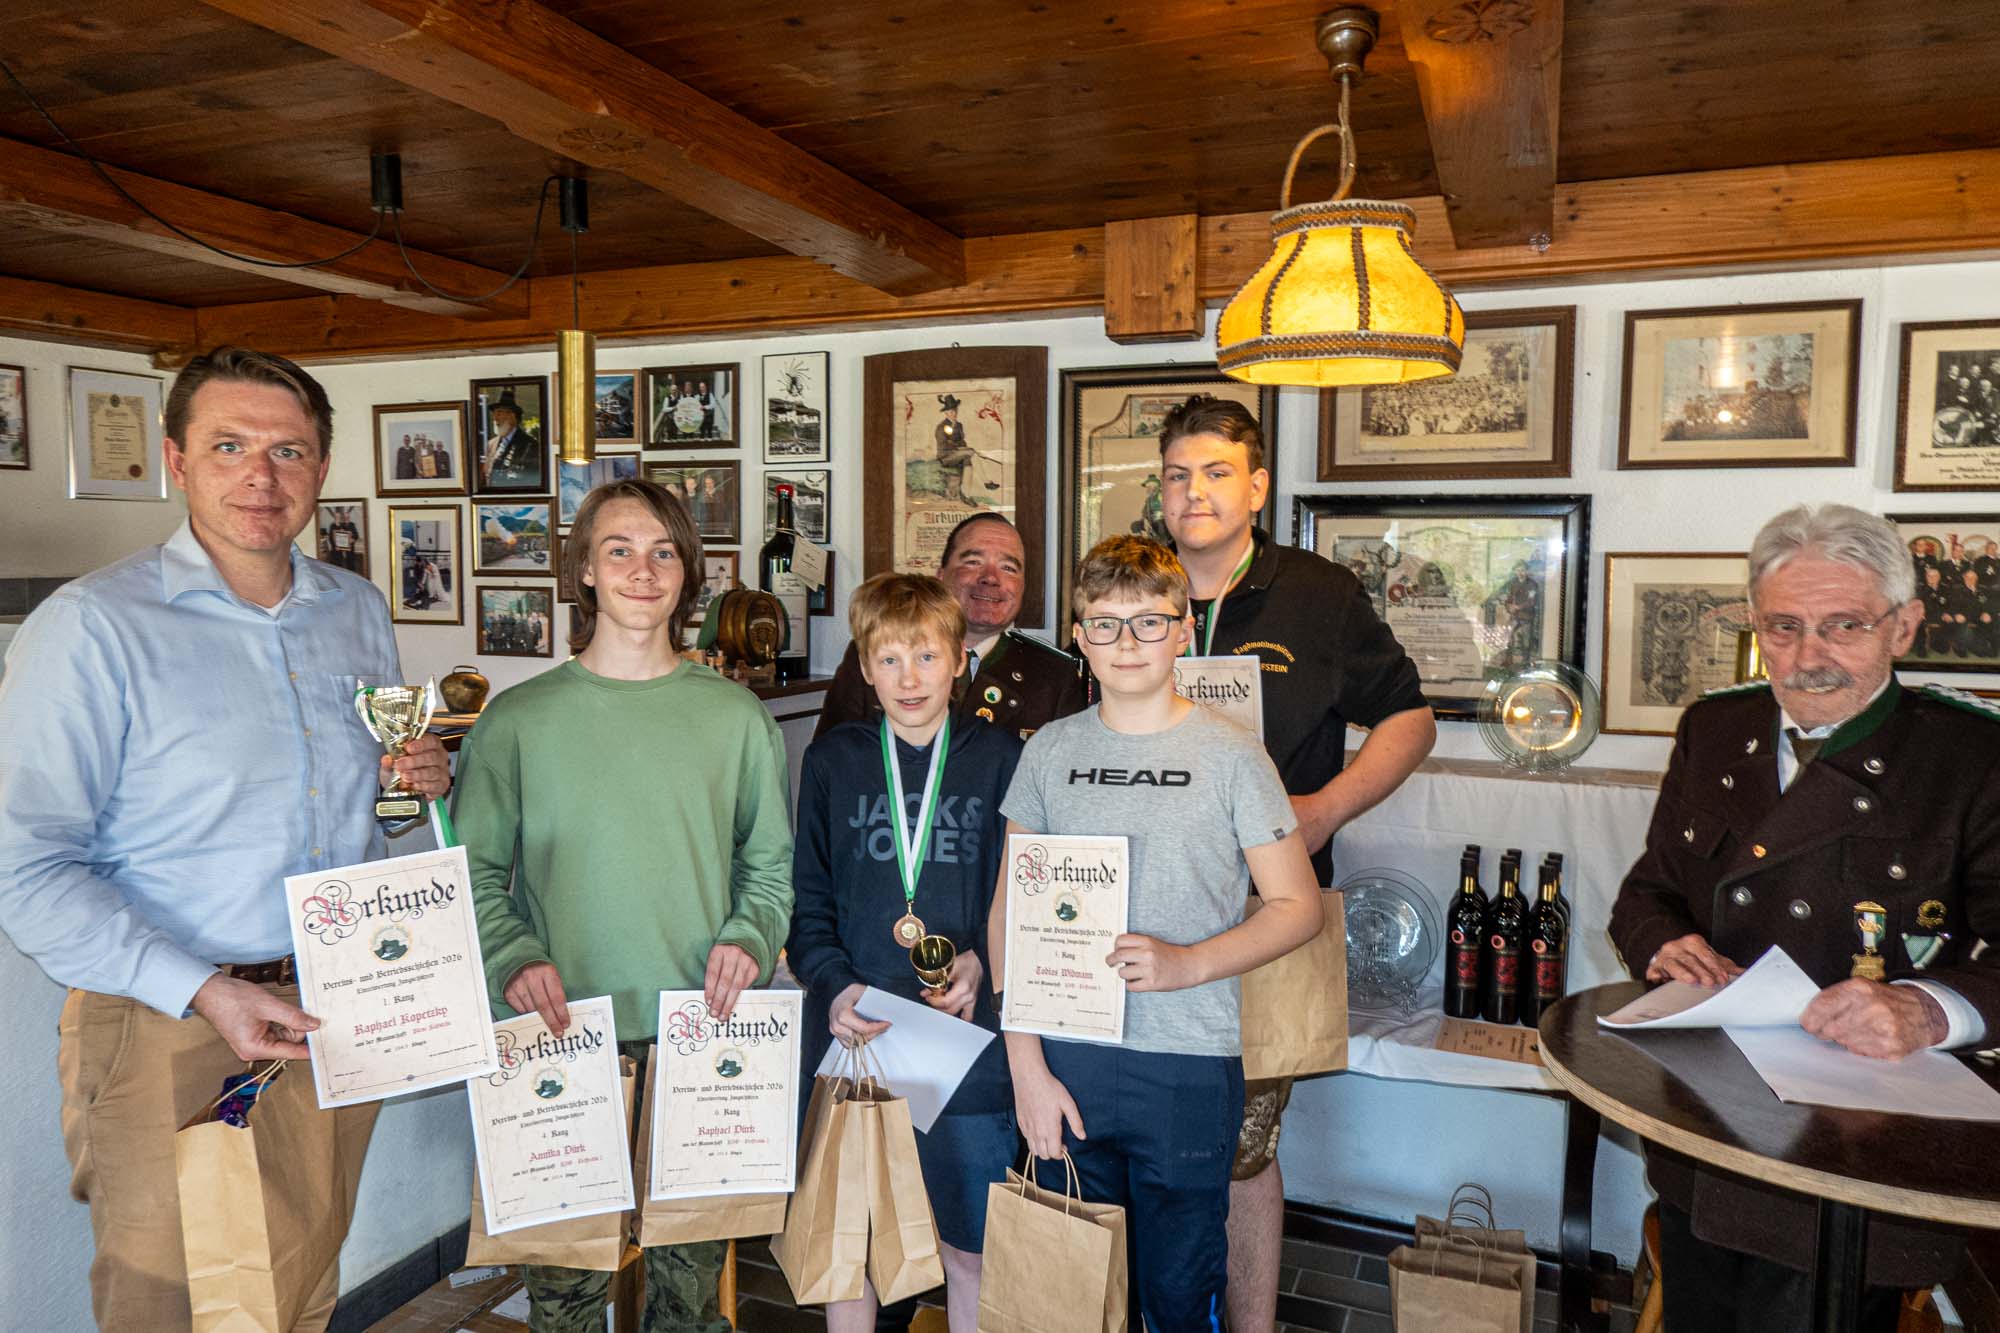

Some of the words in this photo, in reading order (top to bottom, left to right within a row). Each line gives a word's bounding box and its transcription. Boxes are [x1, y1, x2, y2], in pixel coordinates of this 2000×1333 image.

[1261, 663, 1289, 674] FSTEIN
[1176, 668, 1250, 707] rkunde
[1068, 768, 1192, 787] HEAD
[1015, 843, 1118, 896] Urkunde
[302, 878, 457, 946] Urkunde
[360, 971, 374, 984] und
[441, 952, 463, 966] 2026
[393, 993, 415, 1005] Rang
[354, 1016, 397, 1037] Raphael
[667, 999, 789, 1056] Urkunde
